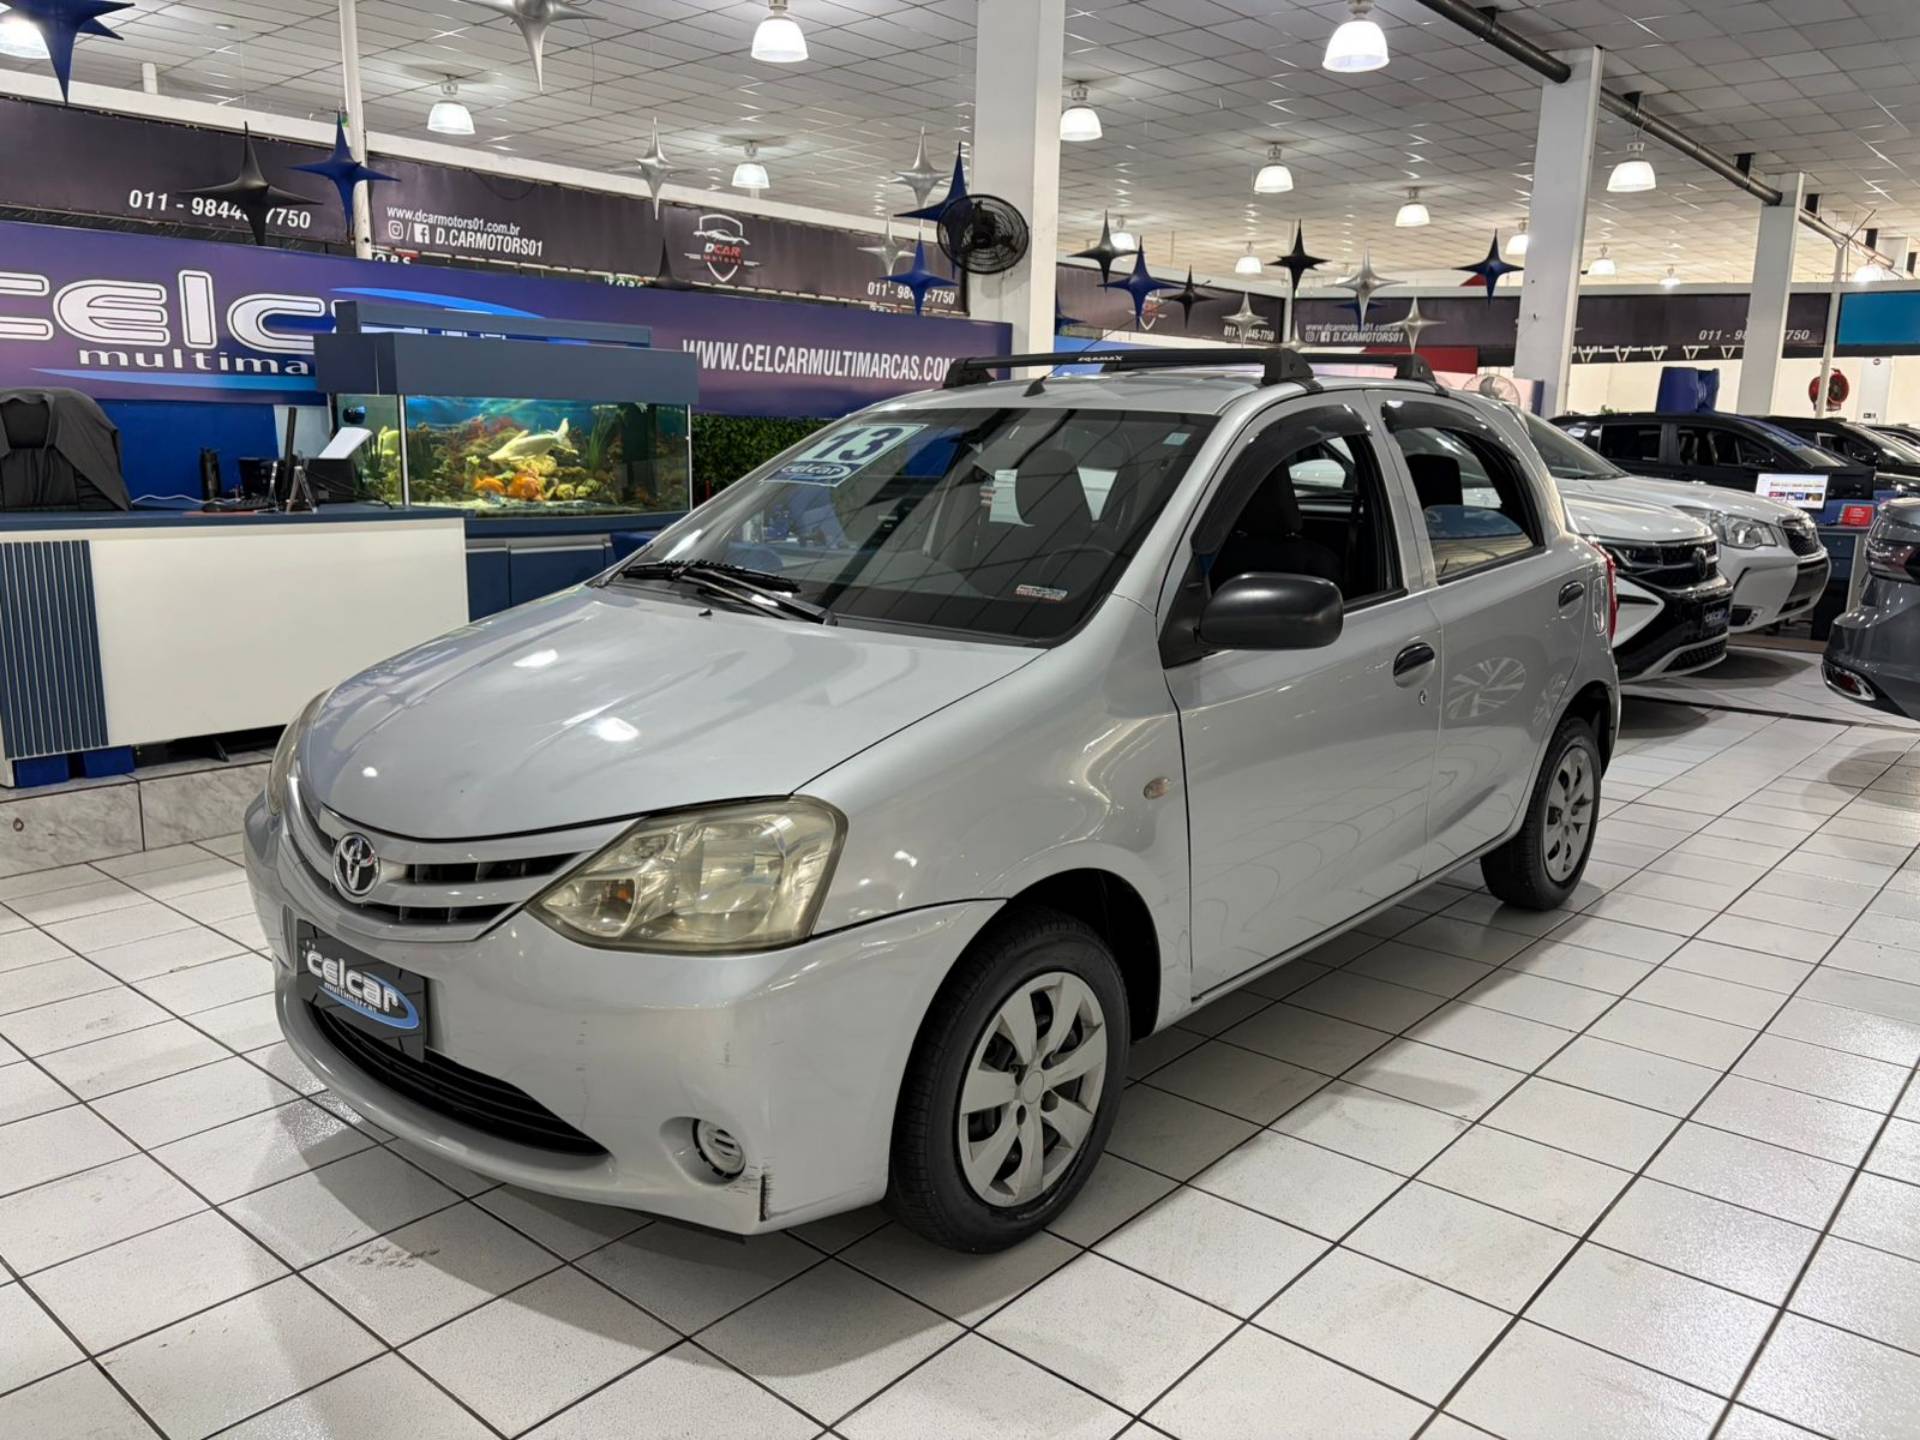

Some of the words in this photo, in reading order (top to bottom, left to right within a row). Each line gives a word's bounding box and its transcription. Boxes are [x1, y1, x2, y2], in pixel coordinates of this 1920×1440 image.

[129, 189, 168, 211] 011
[386, 206, 521, 236] www.dcarmotors01.com.br
[435, 227, 543, 257] D.CARMOTORS01
[867, 281, 887, 296] 011
[0, 269, 340, 355] celc
[1223, 325, 1236, 337] 011
[1332, 331, 1404, 343] D.CARMOTORS01
[1698, 329, 1722, 341] 011
[78, 348, 309, 375] multima
[812, 427, 904, 462] 13
[306, 950, 399, 1013] celcar
